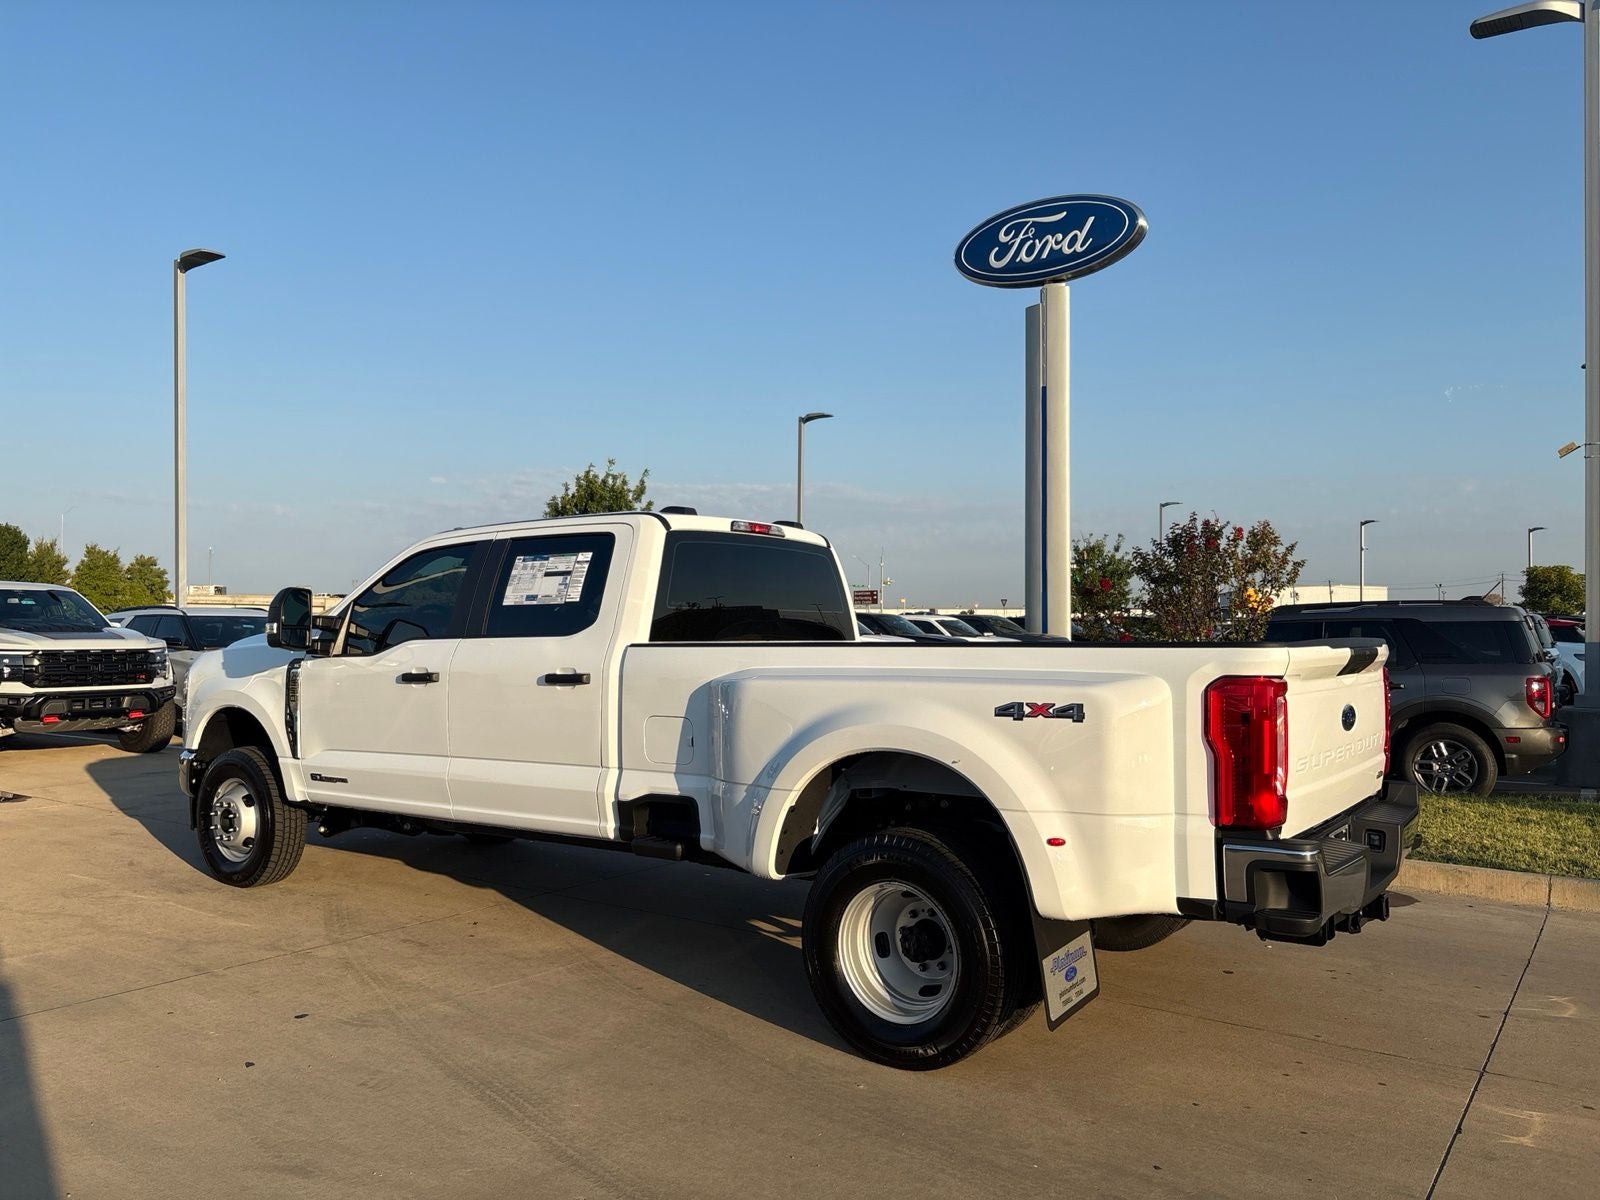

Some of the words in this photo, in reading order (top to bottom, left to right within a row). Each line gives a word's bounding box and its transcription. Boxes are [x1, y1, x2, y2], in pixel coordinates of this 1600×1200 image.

[989, 211, 1095, 268] Ford
[1296, 743, 1355, 775] SUPER
[1357, 730, 1384, 753] DUTY
